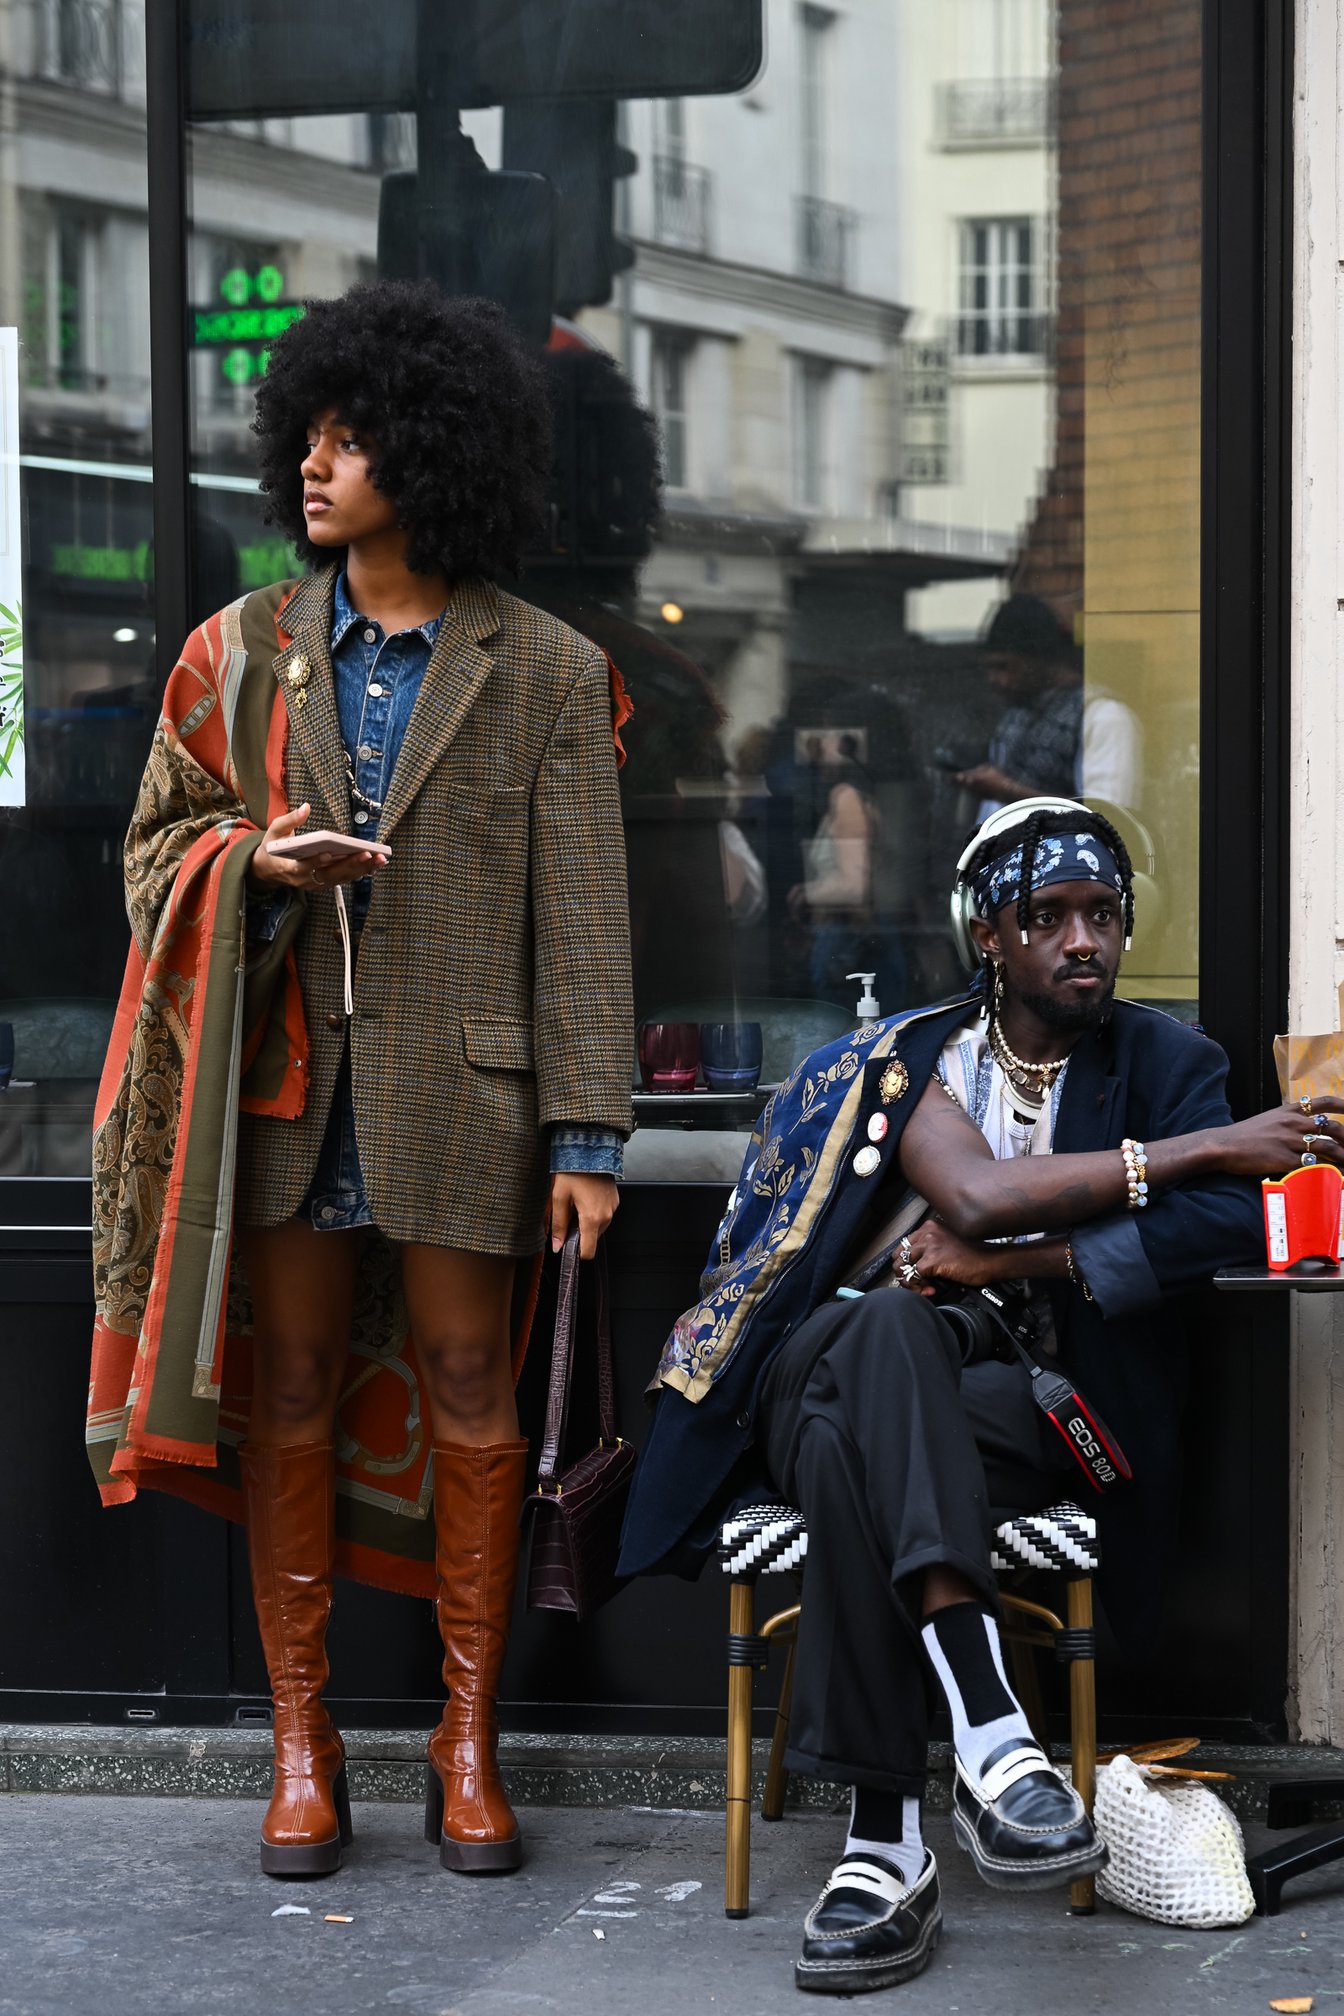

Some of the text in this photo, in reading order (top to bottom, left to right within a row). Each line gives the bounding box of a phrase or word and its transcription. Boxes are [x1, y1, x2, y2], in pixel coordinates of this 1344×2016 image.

[981, 1288, 1004, 1307] Canon
[1068, 1417, 1117, 1483] EOS 80D
